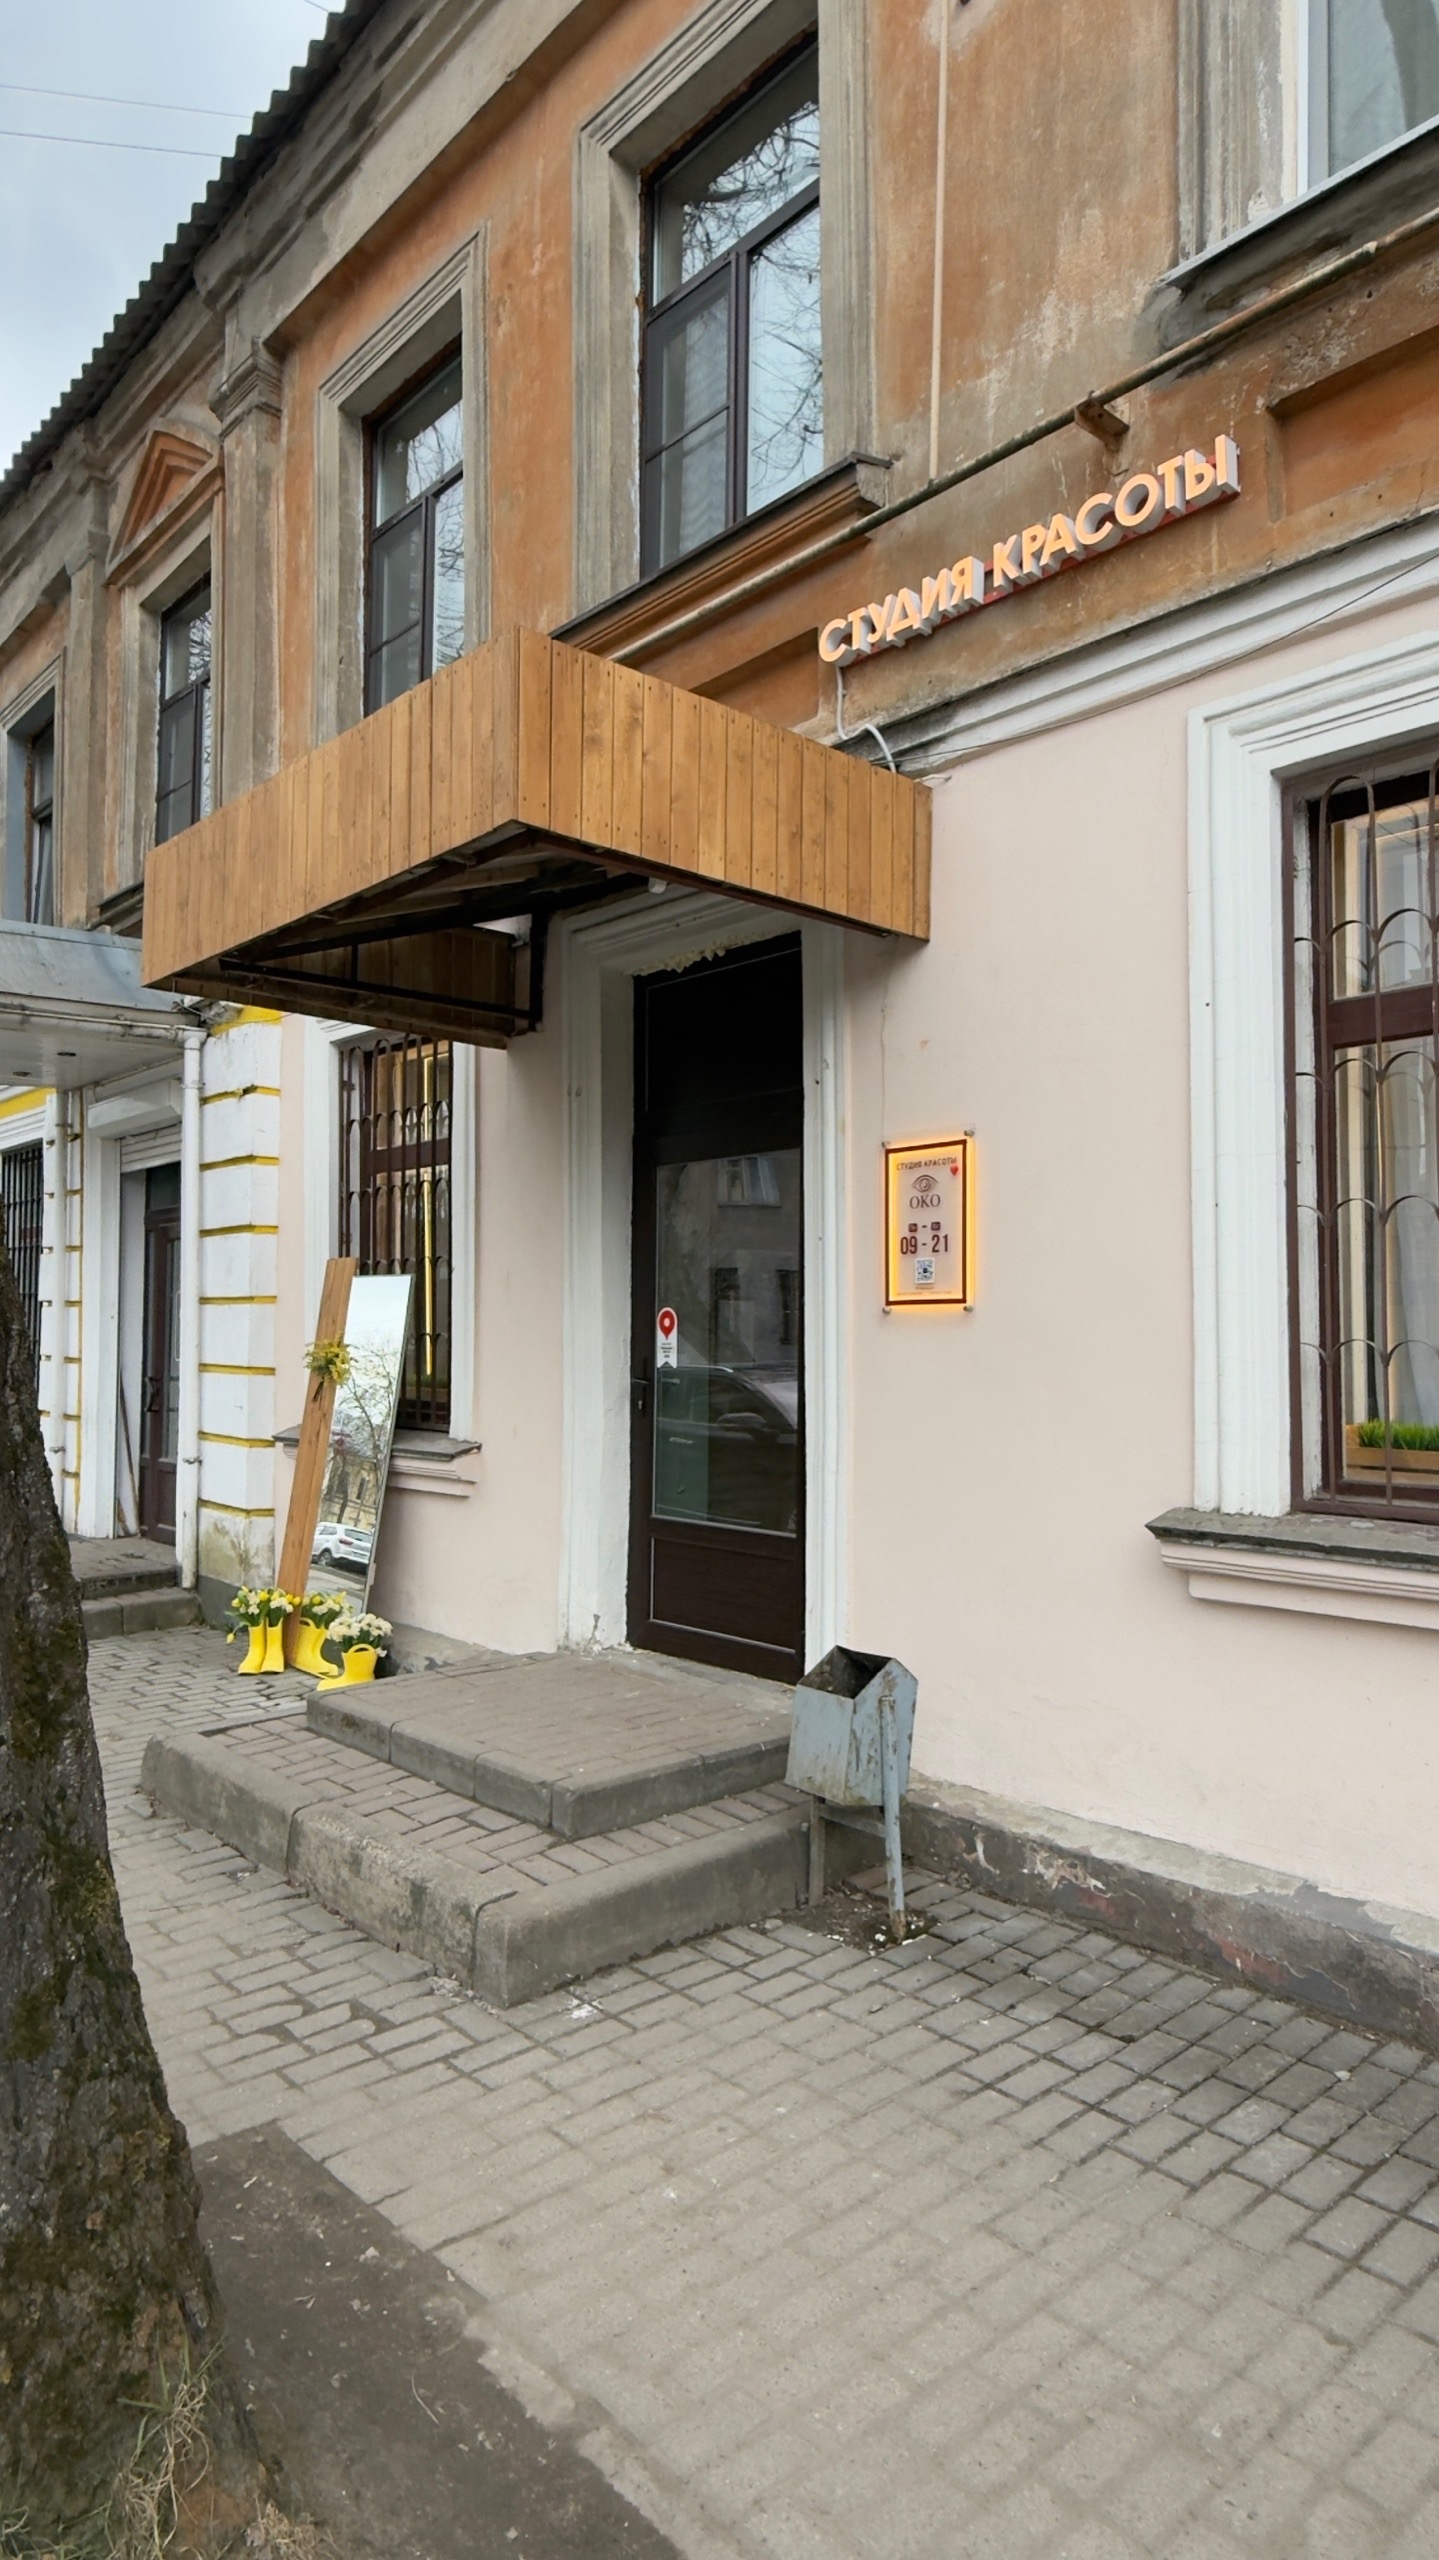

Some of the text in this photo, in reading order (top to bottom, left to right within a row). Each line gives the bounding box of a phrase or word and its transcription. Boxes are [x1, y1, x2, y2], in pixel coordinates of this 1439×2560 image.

[818, 434, 1238, 664] СТУДИЯ КРАСОТЫ
[896, 1157, 957, 1170] СТУДИЯ КРАСОТЫ
[900, 1236, 918, 1254] 09
[931, 1234, 948, 1253] 21
